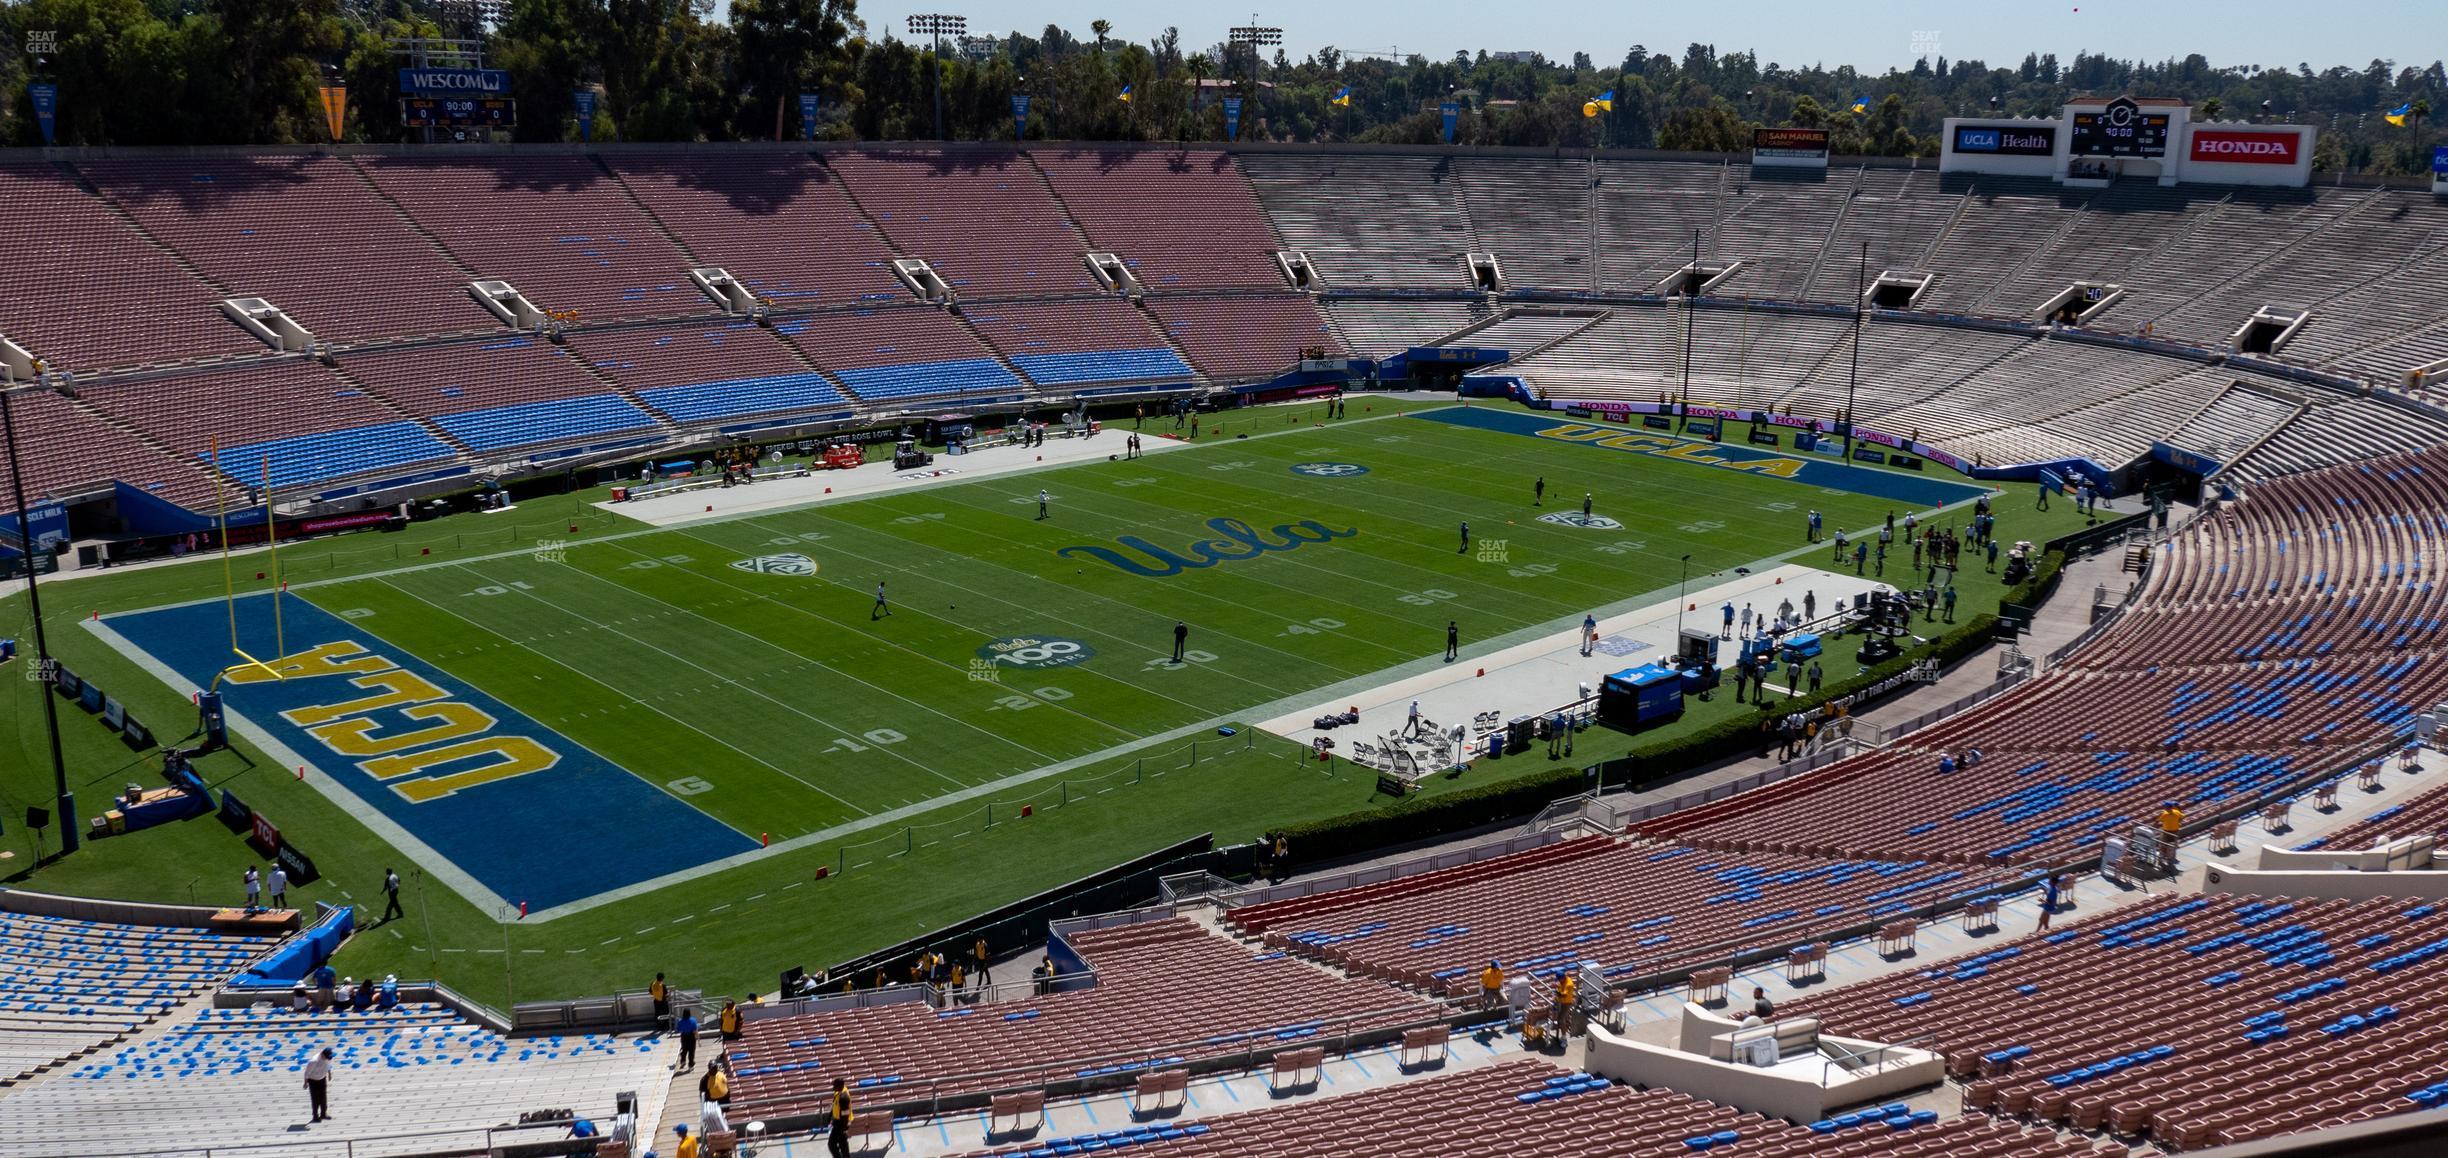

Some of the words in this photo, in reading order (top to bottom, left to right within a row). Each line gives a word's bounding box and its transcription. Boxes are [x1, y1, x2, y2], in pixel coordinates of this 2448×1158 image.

[412, 73, 481, 89] WESCOM
[1768, 132, 1787, 140] SAN
[1788, 132, 1825, 141] MANUEL
[1964, 134, 1994, 145] UCLA
[2002, 133, 2047, 148] Health
[2198, 140, 2288, 155] HONDA
[2087, 288, 2102, 301] 40
[1578, 401, 1632, 411] HONDA
[1606, 412, 1625, 422] TCL
[852, 432, 871, 440] ROSE
[1534, 424, 1809, 478] UCLA
[1927, 449, 1957, 468] HONDA
[1056, 517, 1358, 577] Ucla
[1397, 588, 1459, 606] 50
[1287, 617, 1346, 635] 40
[996, 641, 1081, 665] 100
[1035, 653, 1087, 668] YEARS
[1146, 650, 1219, 671] 30
[994, 687, 1074, 711] 20
[222, 640, 564, 804] UCLA
[832, 728, 908, 753] 10
[666, 776, 714, 796] G
[256, 818, 275, 847] TCL
[278, 846, 306, 876] NISSAN
